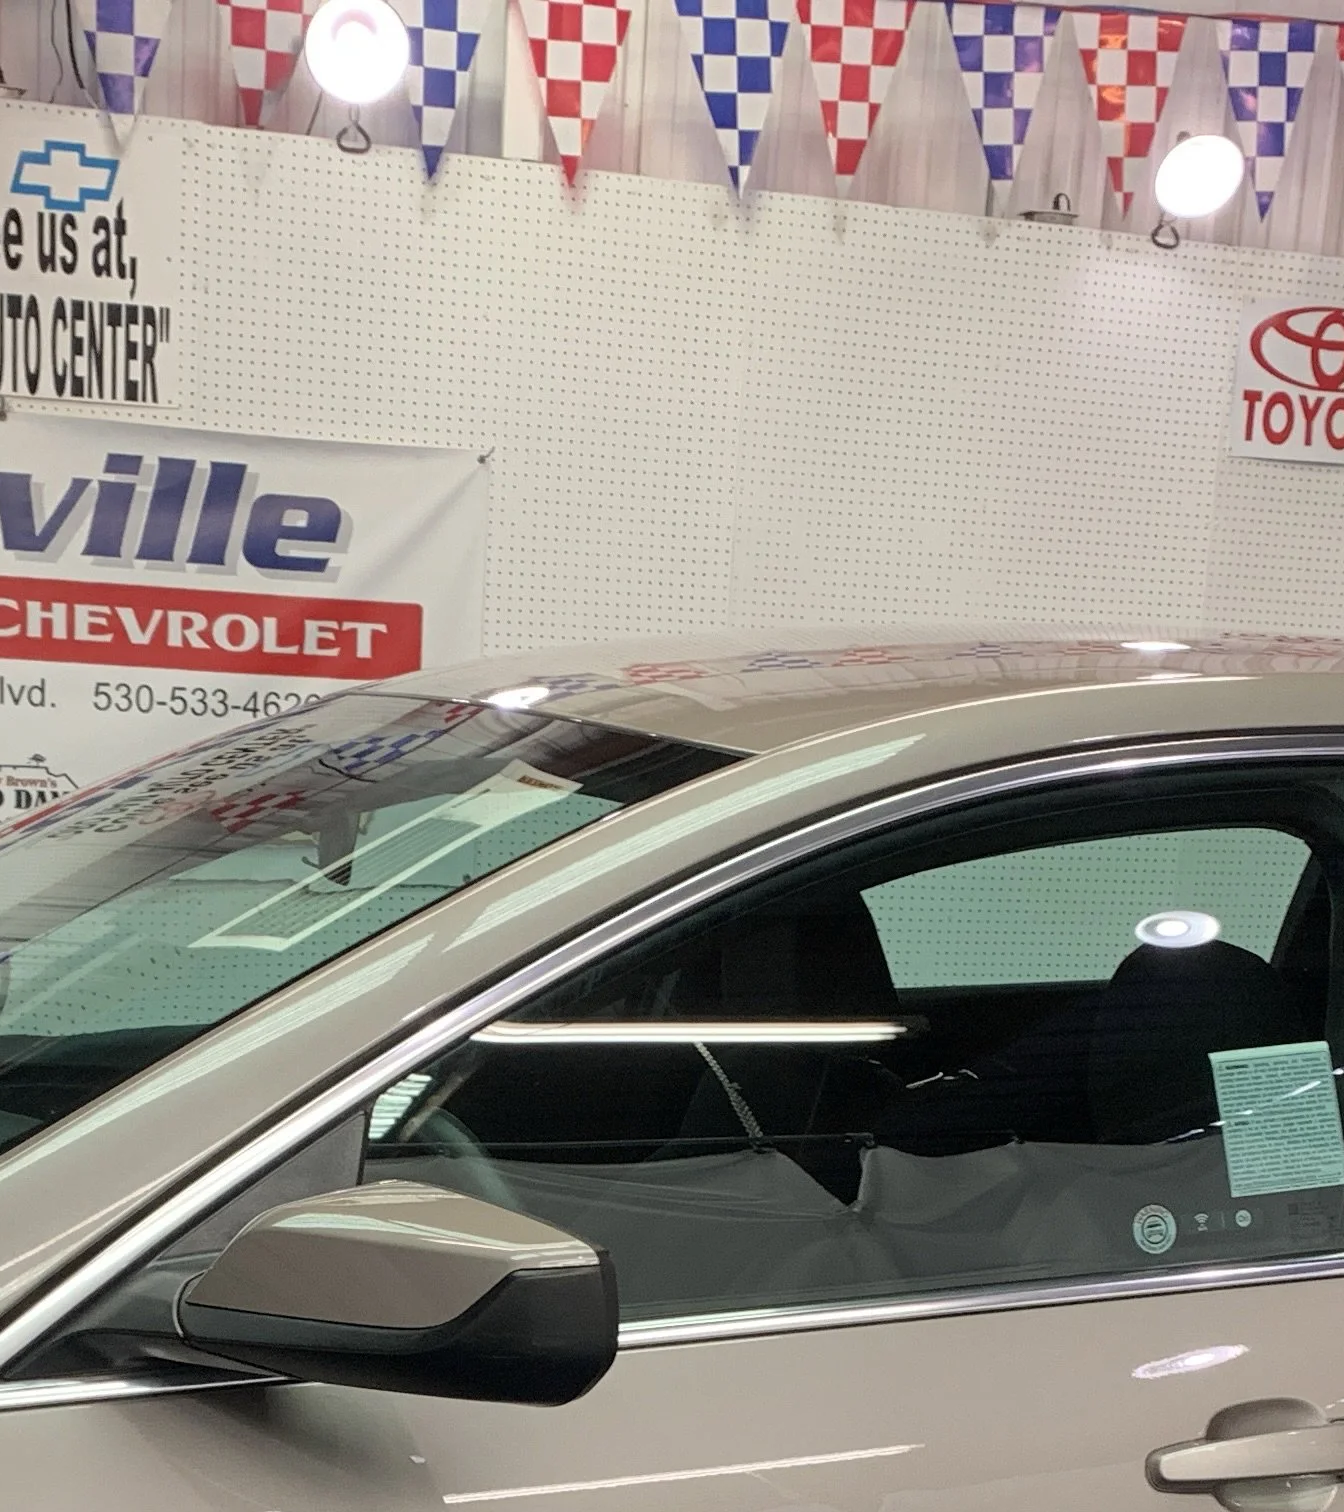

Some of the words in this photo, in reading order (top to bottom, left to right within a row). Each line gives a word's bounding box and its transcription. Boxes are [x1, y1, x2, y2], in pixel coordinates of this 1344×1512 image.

[37, 210, 79, 275] us
[91, 197, 138, 300] at,
[51, 296, 171, 404] CENTER"
